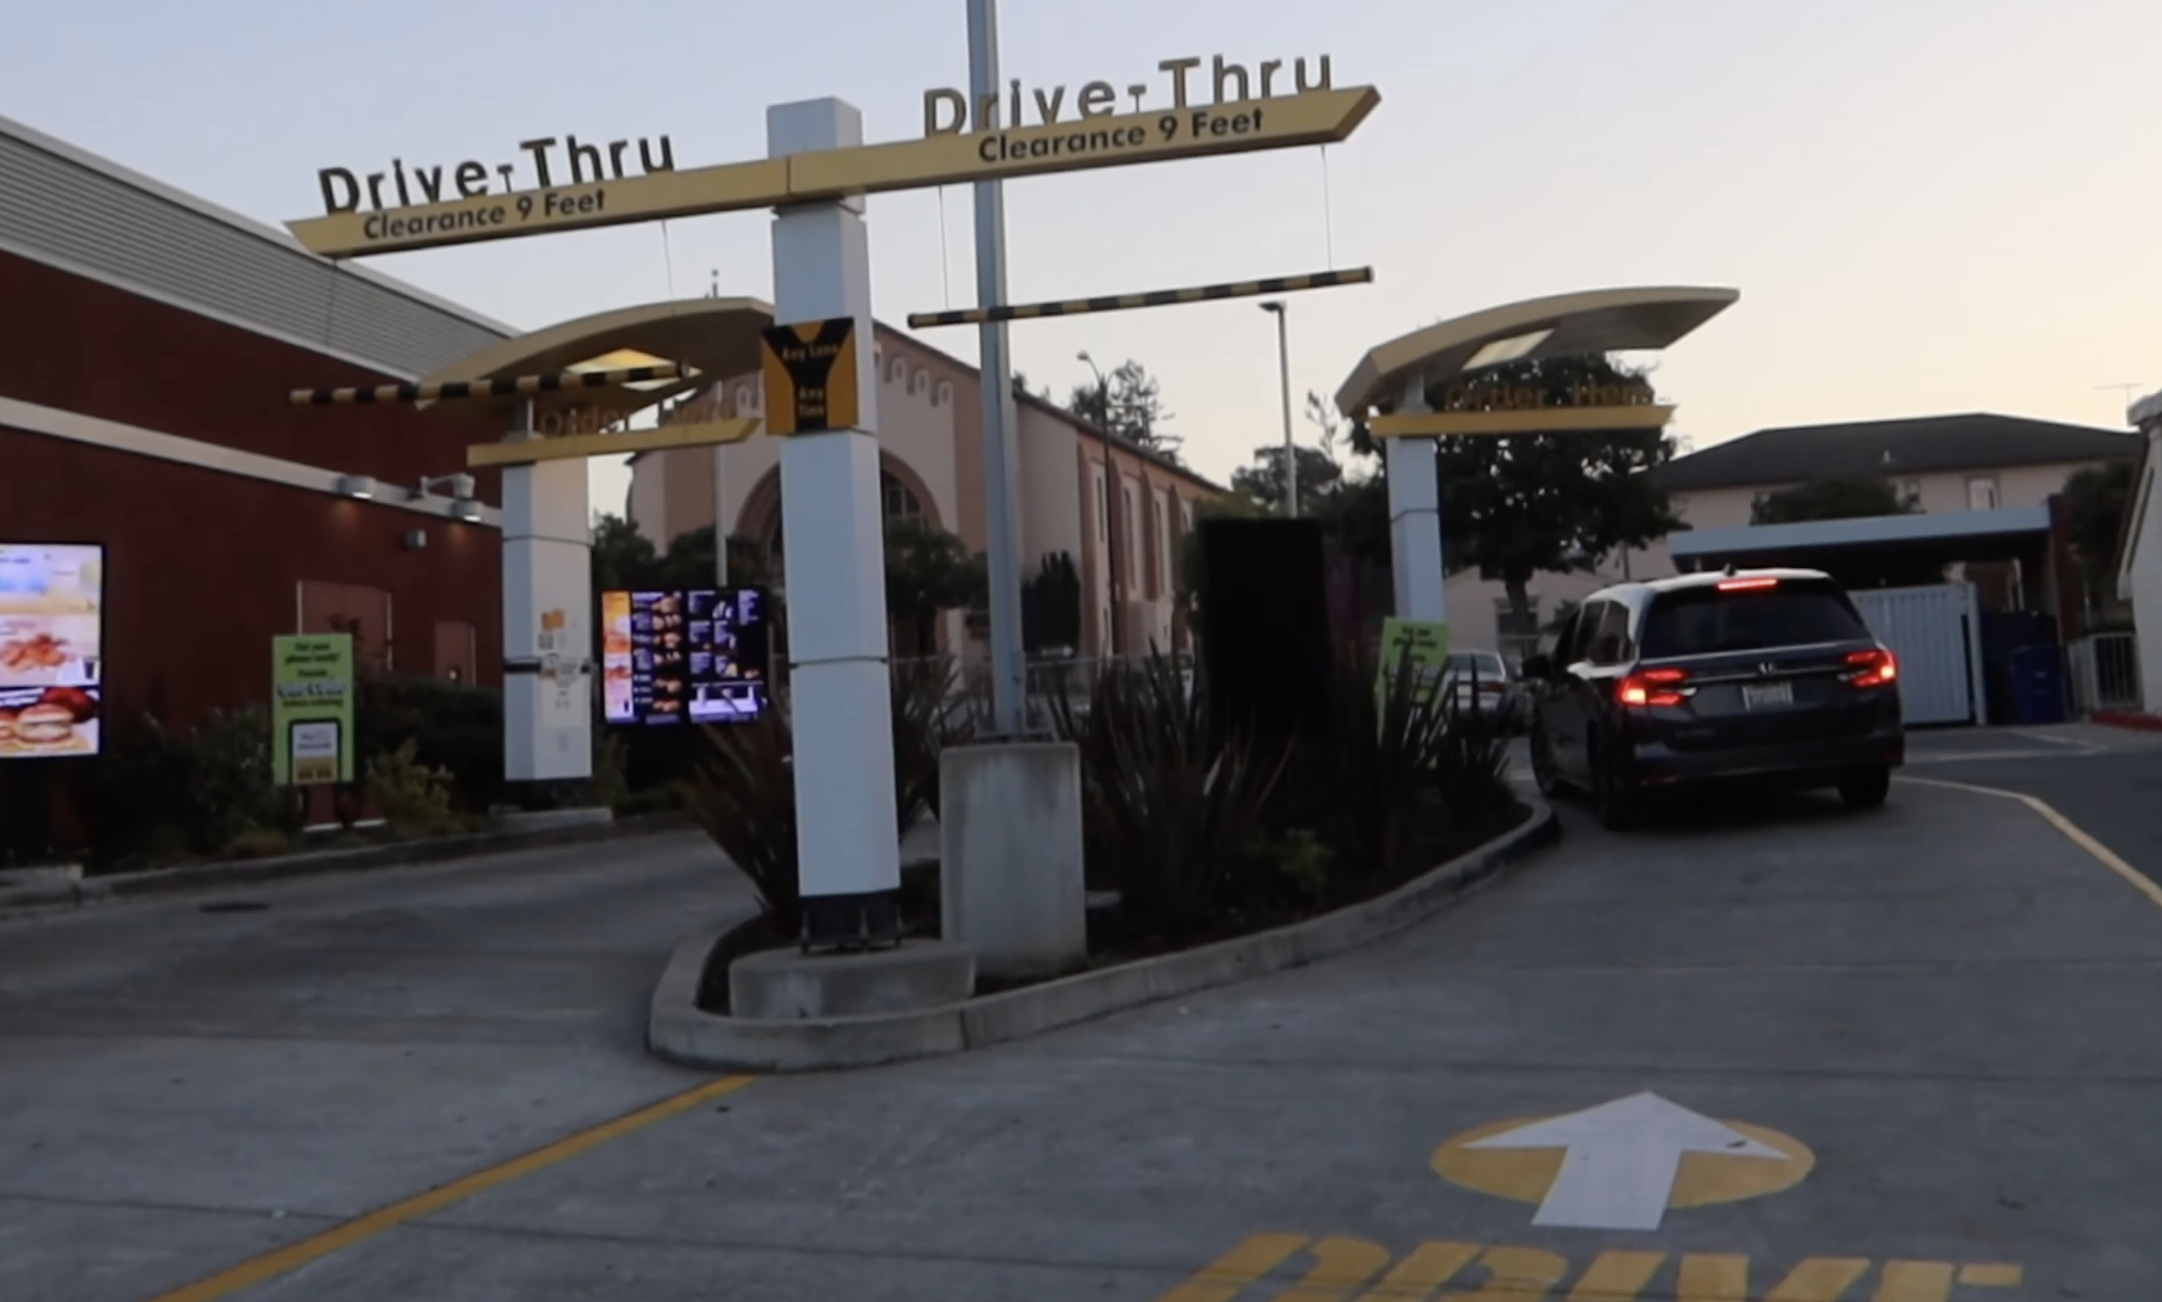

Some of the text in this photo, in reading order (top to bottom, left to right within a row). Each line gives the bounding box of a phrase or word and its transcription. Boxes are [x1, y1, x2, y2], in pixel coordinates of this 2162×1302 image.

[923, 53, 1331, 138] Drive-Thru
[978, 107, 1263, 162] Clearance 9 Feet
[317, 134, 675, 216] Drive-Thru
[362, 189, 605, 240] Clearance 9 Feet
